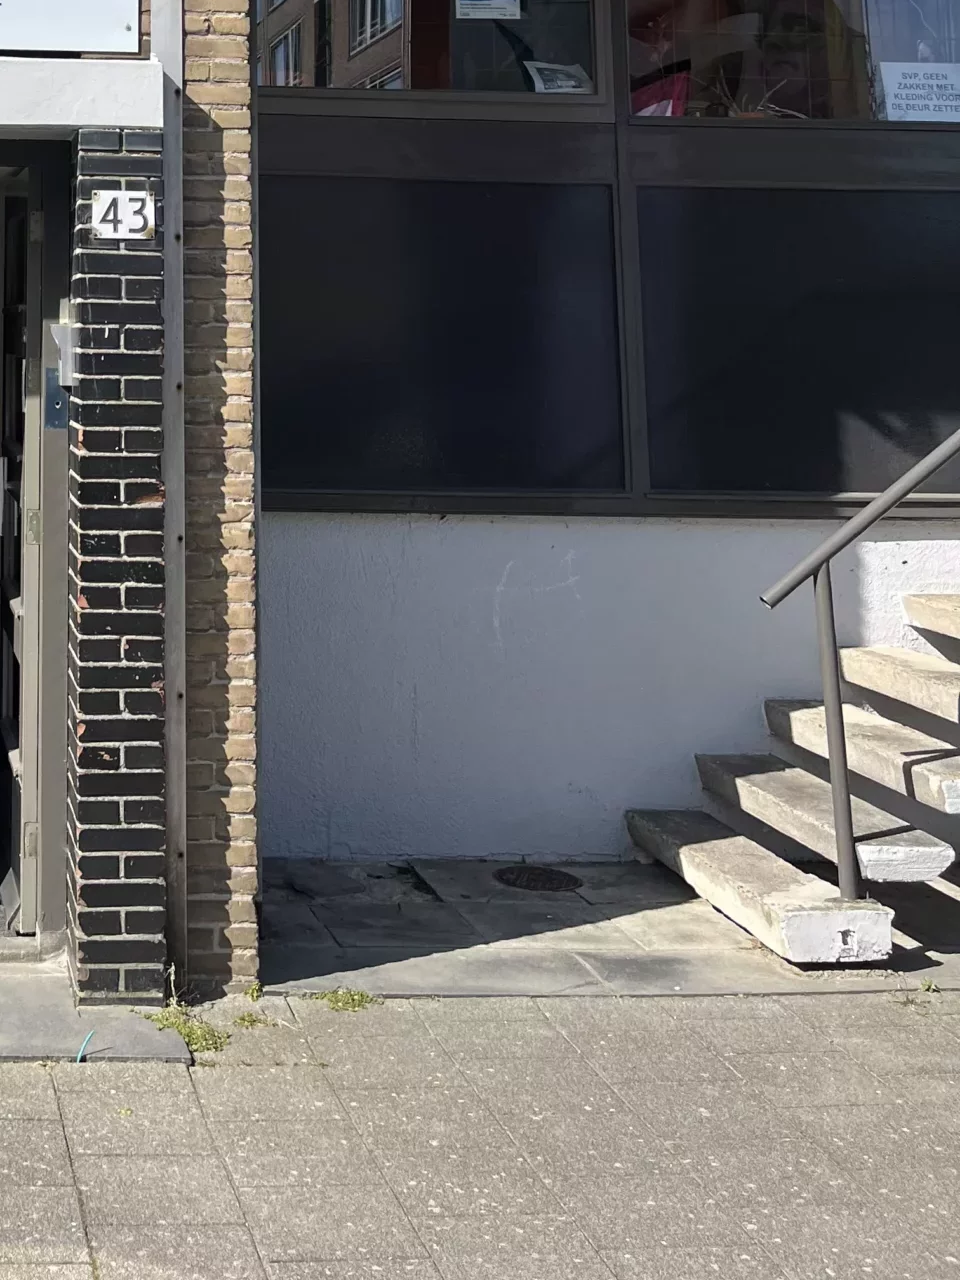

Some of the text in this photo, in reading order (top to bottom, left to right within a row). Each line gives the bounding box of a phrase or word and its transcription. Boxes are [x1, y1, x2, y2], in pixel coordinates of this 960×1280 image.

[923, 73, 948, 81] GEEN
[897, 83, 954, 92] ZAKKEN MET
[893, 92, 933, 101] KLEDING
[891, 103, 960, 113] DE DEUR ZETTE
[99, 197, 149, 234] 43
